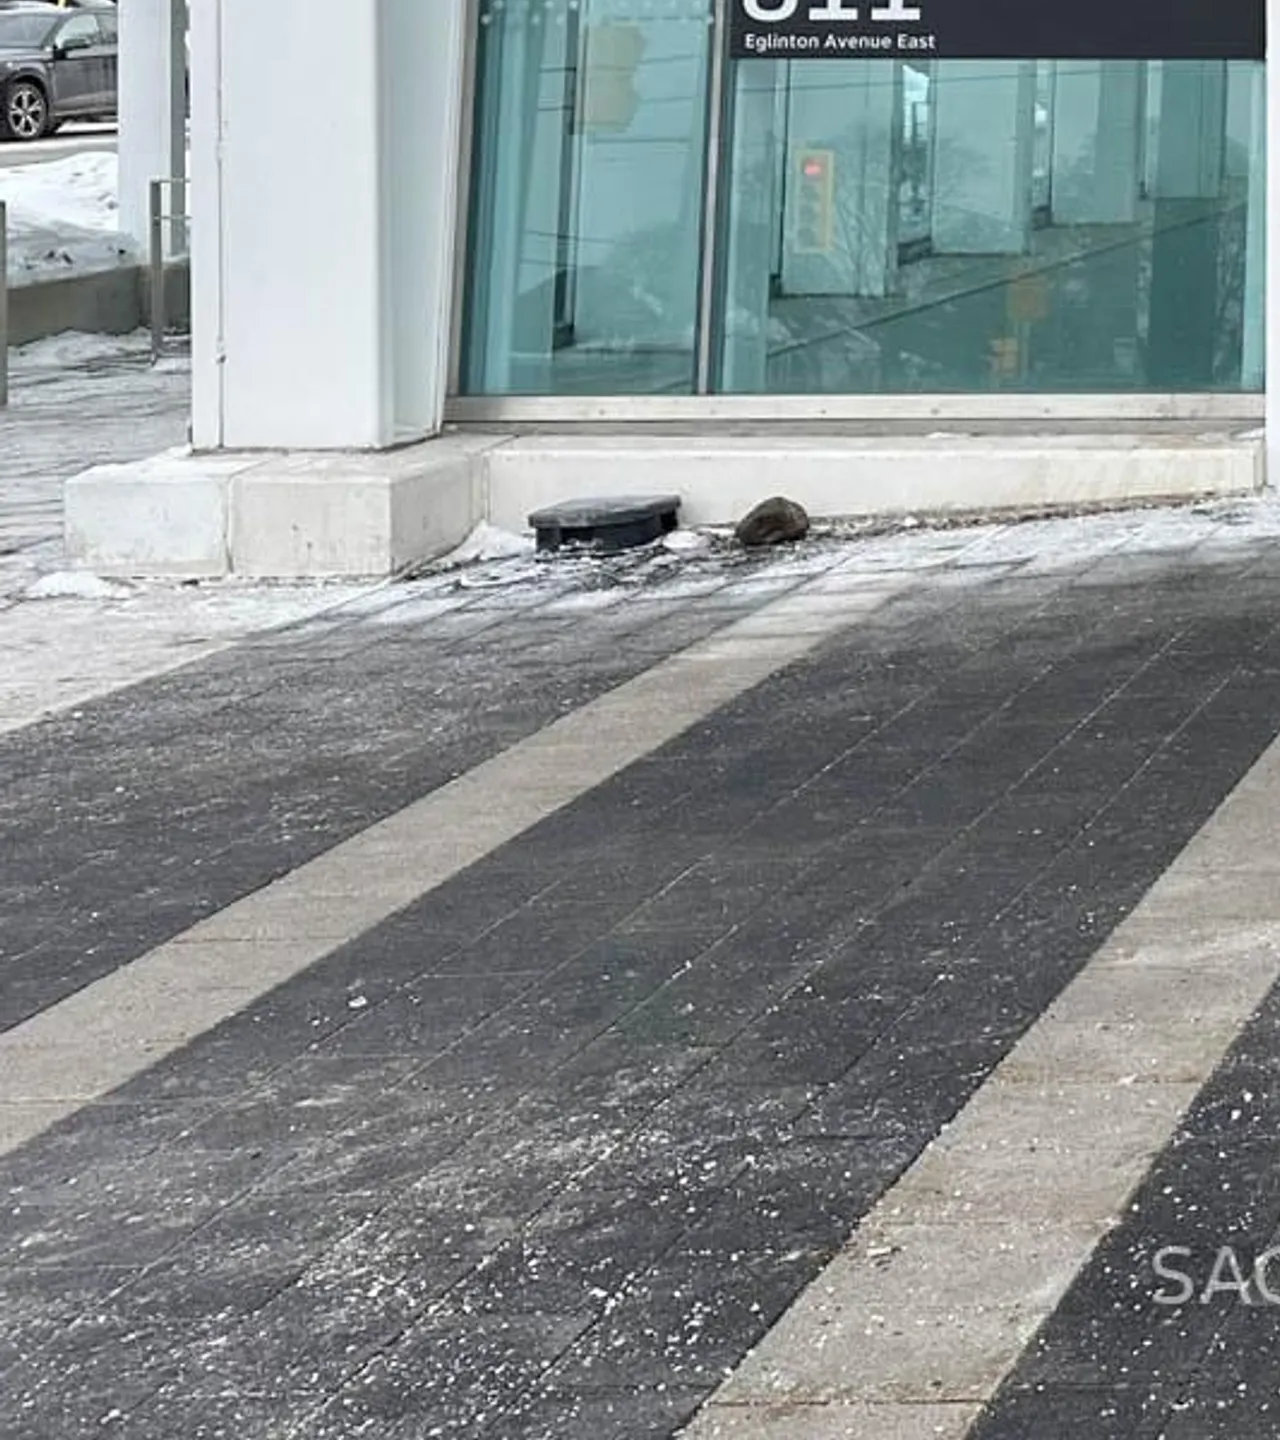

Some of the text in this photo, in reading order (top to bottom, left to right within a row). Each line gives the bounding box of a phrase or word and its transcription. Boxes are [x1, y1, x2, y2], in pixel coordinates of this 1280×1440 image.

[744, 33, 936, 52] Eglinton Avenue East
